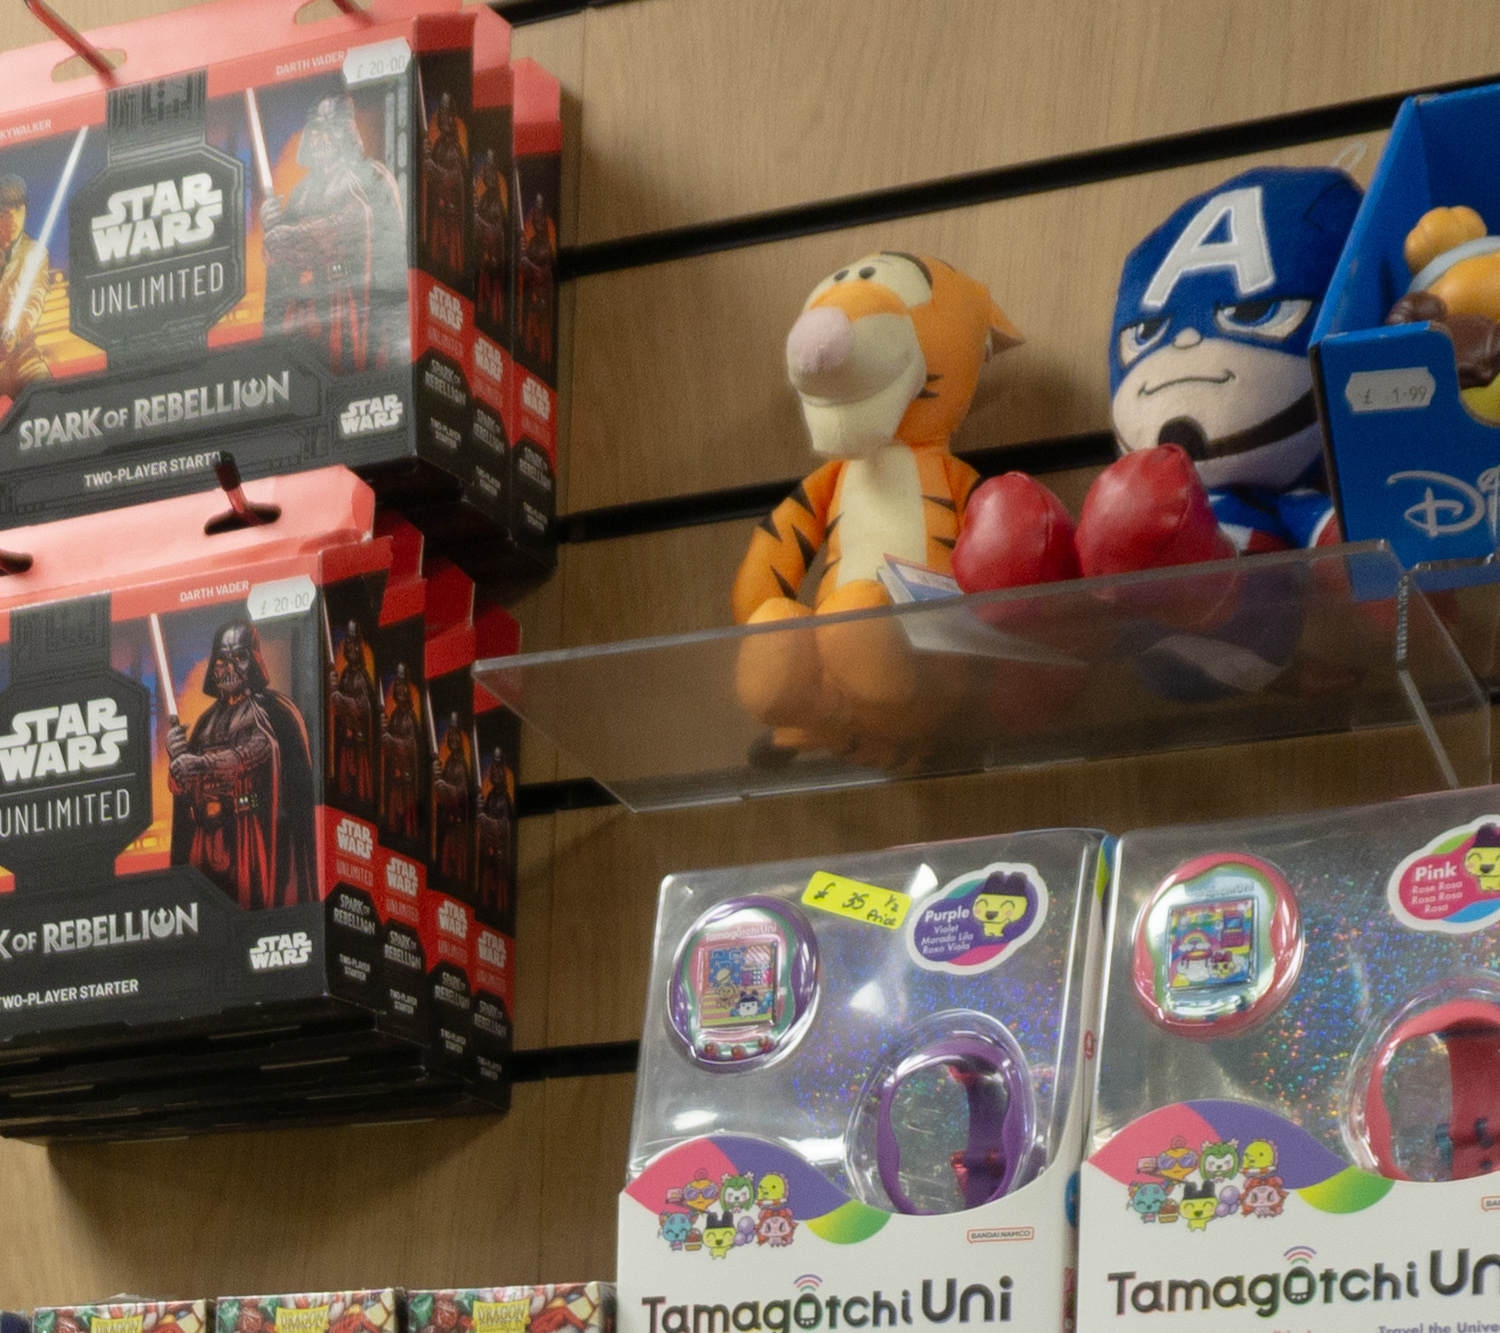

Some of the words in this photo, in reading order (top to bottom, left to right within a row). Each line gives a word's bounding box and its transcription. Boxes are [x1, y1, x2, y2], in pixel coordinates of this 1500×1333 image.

[92, 172, 224, 230] STAR
[91, 211, 221, 264] WARS
[90, 262, 225, 318] UNLIMITED
[18, 406, 101, 453] SPARK
[103, 407, 130, 431] OF
[133, 370, 291, 432] REBELLION
[178, 586, 214, 605] DARTH
[214, 579, 250, 600] VADER
[1413, 862, 1458, 885] Pink
[12, 930, 39, 953] OF
[41, 901, 199, 955] REBELLION
[924, 904, 971, 924] Purple
[249, 944, 314, 970] WARS
[254, 930, 309, 953] STAR
[80, 978, 140, 1002] STARTER
[920, 1274, 1015, 1325] Uni
[1106, 1260, 1420, 1318] Tamagotchi
